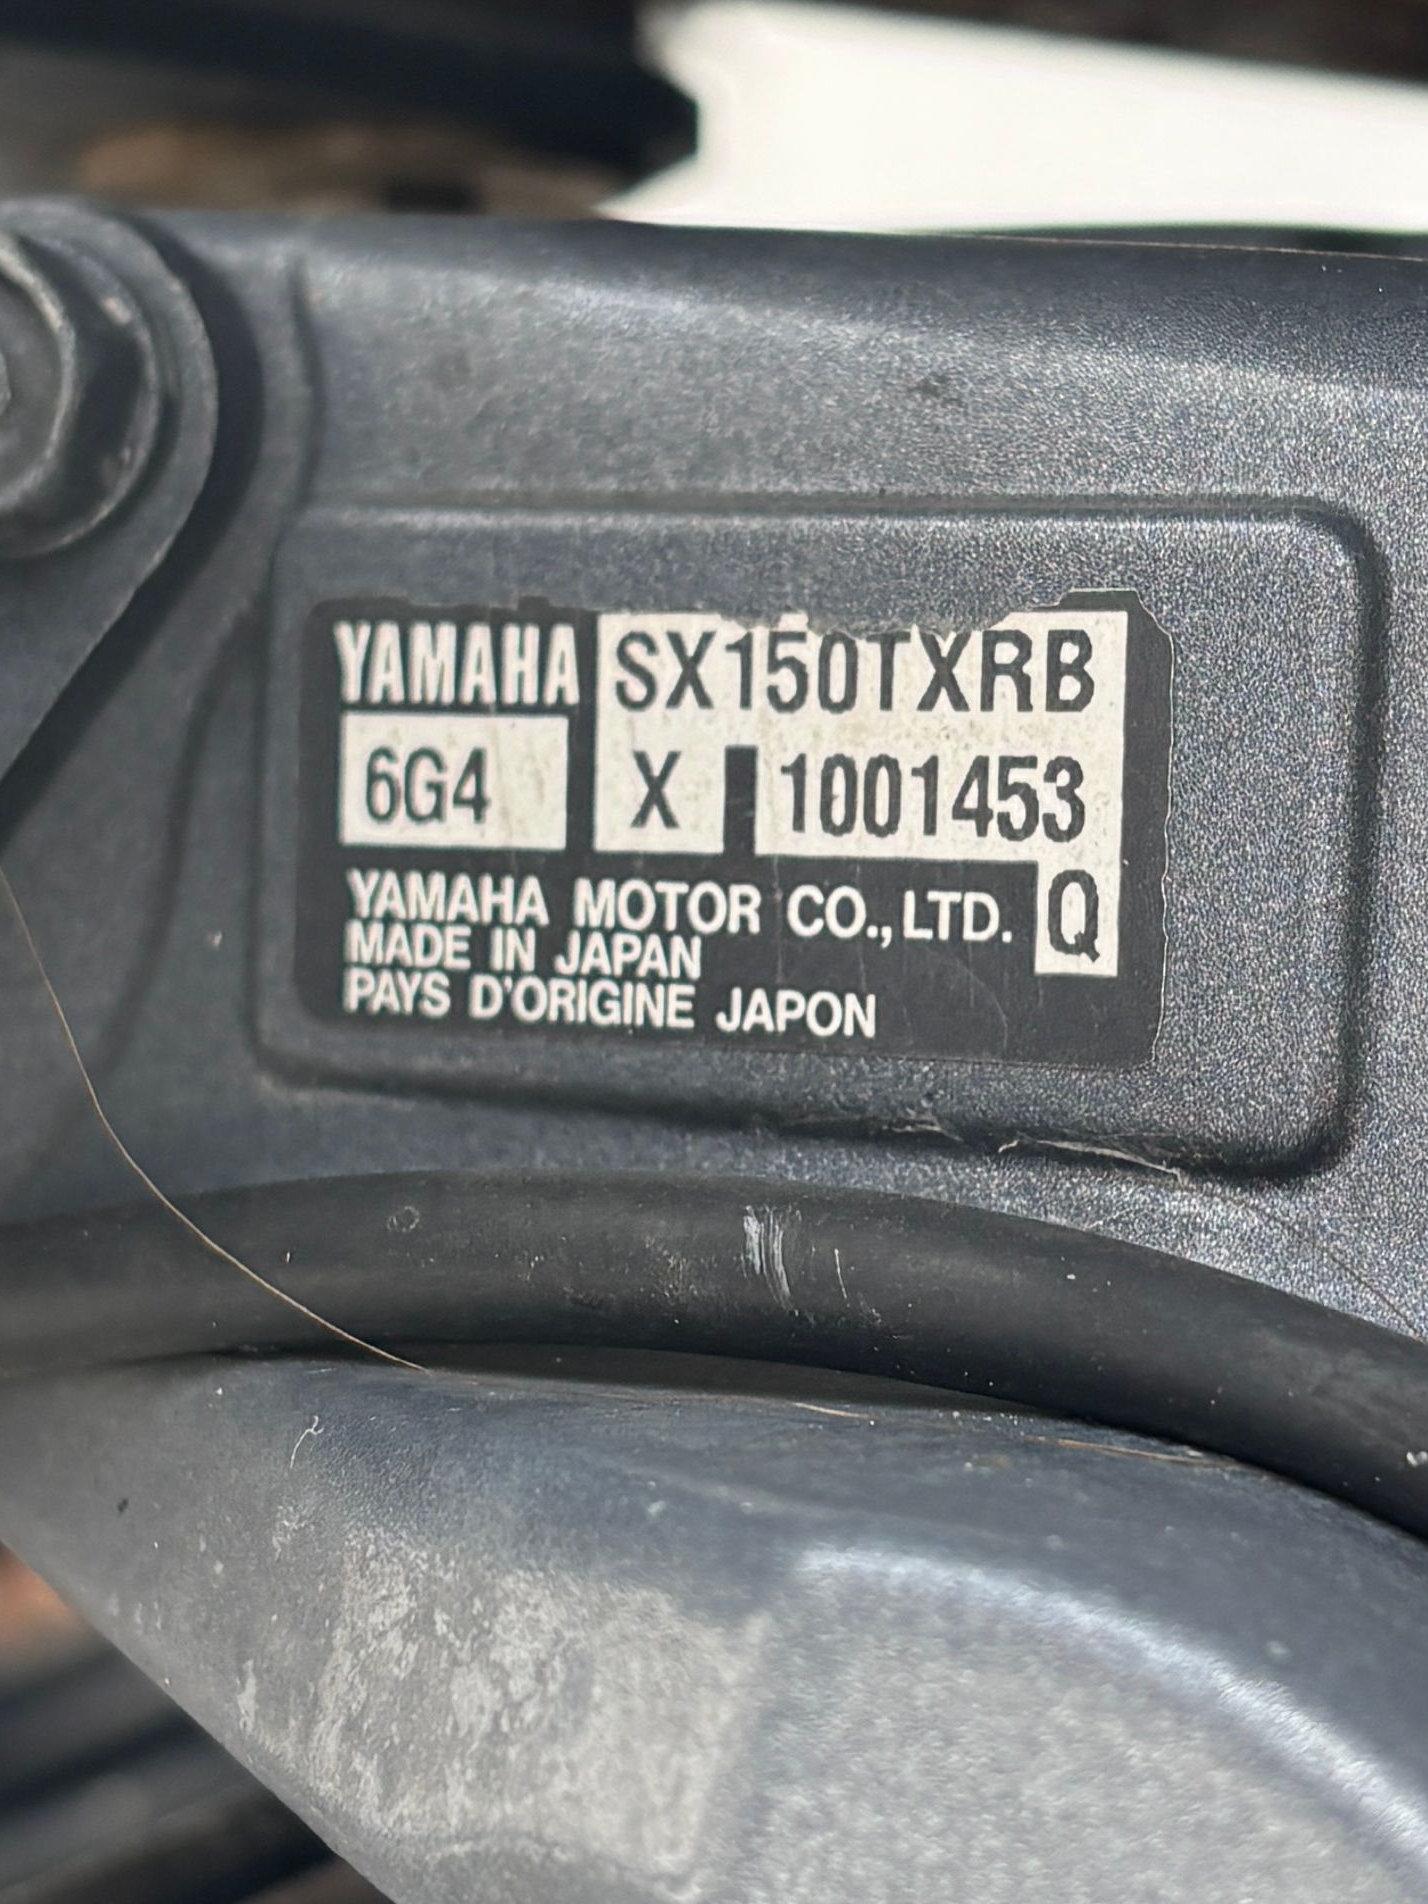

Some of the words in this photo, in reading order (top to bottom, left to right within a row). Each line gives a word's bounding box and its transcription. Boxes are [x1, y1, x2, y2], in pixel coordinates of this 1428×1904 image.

[333, 620, 580, 705] YAMAHA
[615, 629, 1095, 714] SX150TXRB
[367, 747, 491, 826] 6G4
[630, 750, 681, 829] X
[780, 752, 1086, 843] 1001453
[346, 868, 549, 928] YAMAHA
[574, 876, 762, 934] MOTOR
[1048, 869, 1101, 963] Q
[345, 920, 471, 971] MADE
[489, 927, 536, 972] IN
[554, 930, 702, 980] JAPAN
[343, 967, 451, 1018] PAYS
[469, 973, 696, 1028] D'ORIGINE
[716, 986, 876, 1038] JAPON
